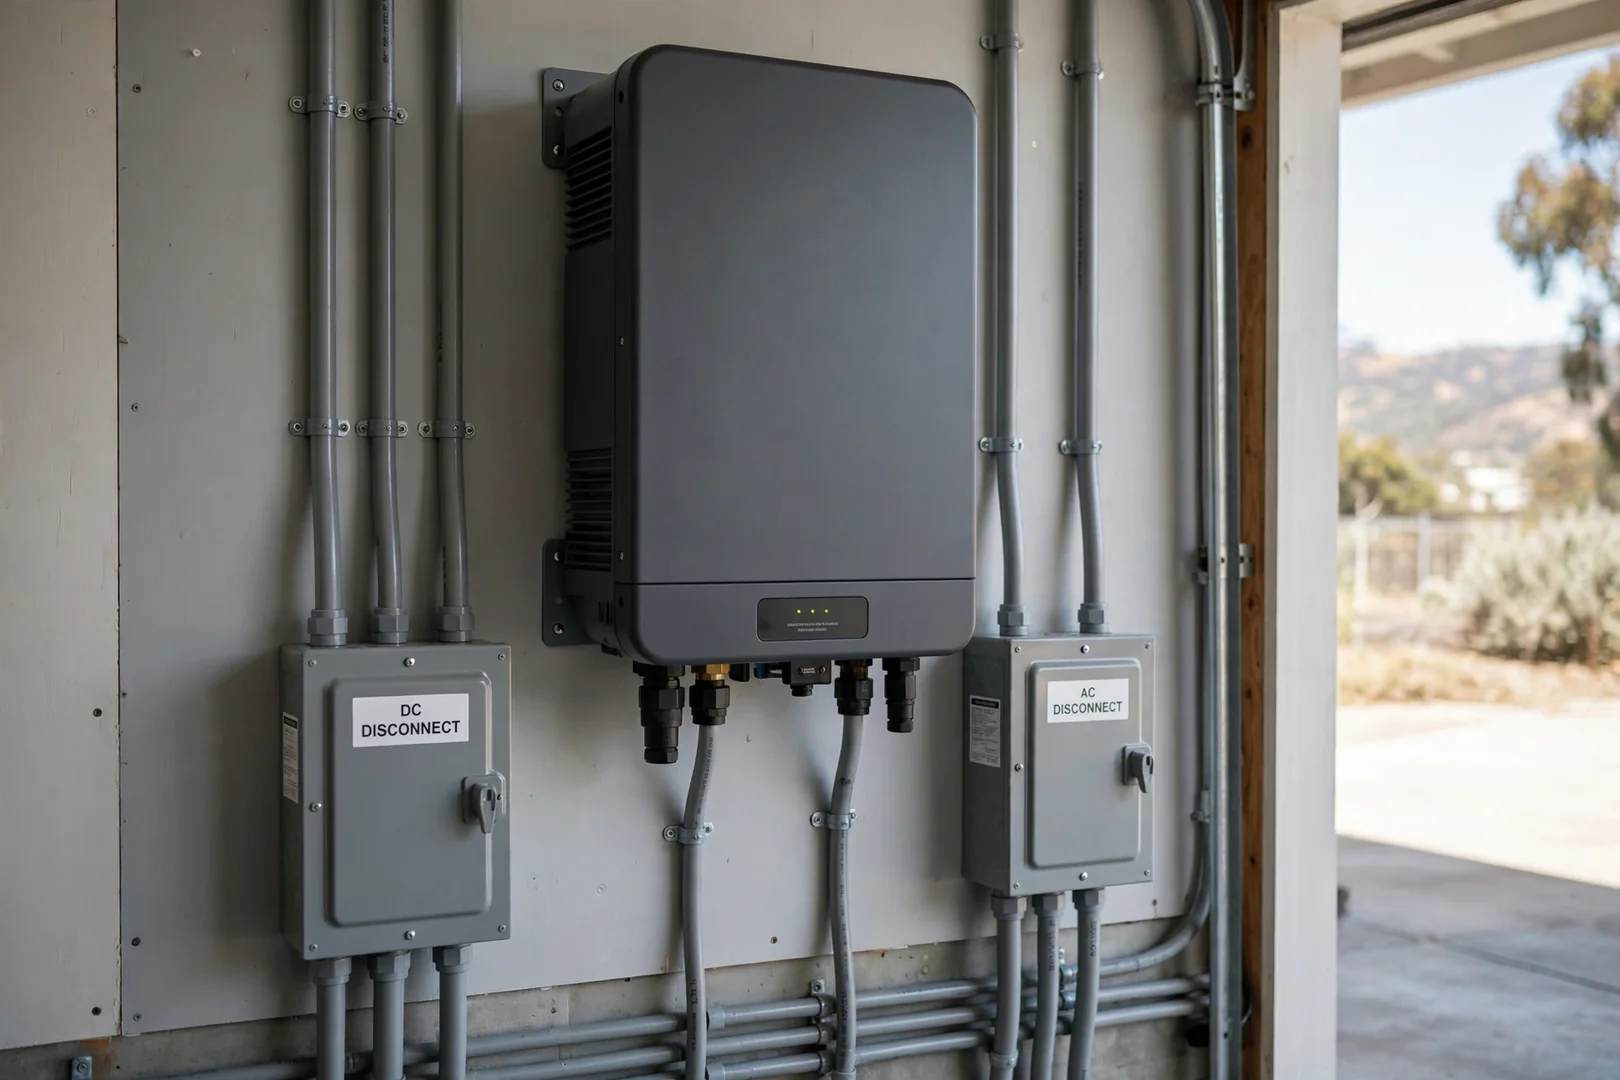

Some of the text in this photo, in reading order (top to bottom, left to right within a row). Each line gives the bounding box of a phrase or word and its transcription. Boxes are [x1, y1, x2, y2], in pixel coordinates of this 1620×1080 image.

[1080, 686, 1096, 698] AC
[400, 703, 422, 717] DC
[1053, 700, 1123, 715] DISCONNECT
[361, 720, 461, 738] DISCONNECT
